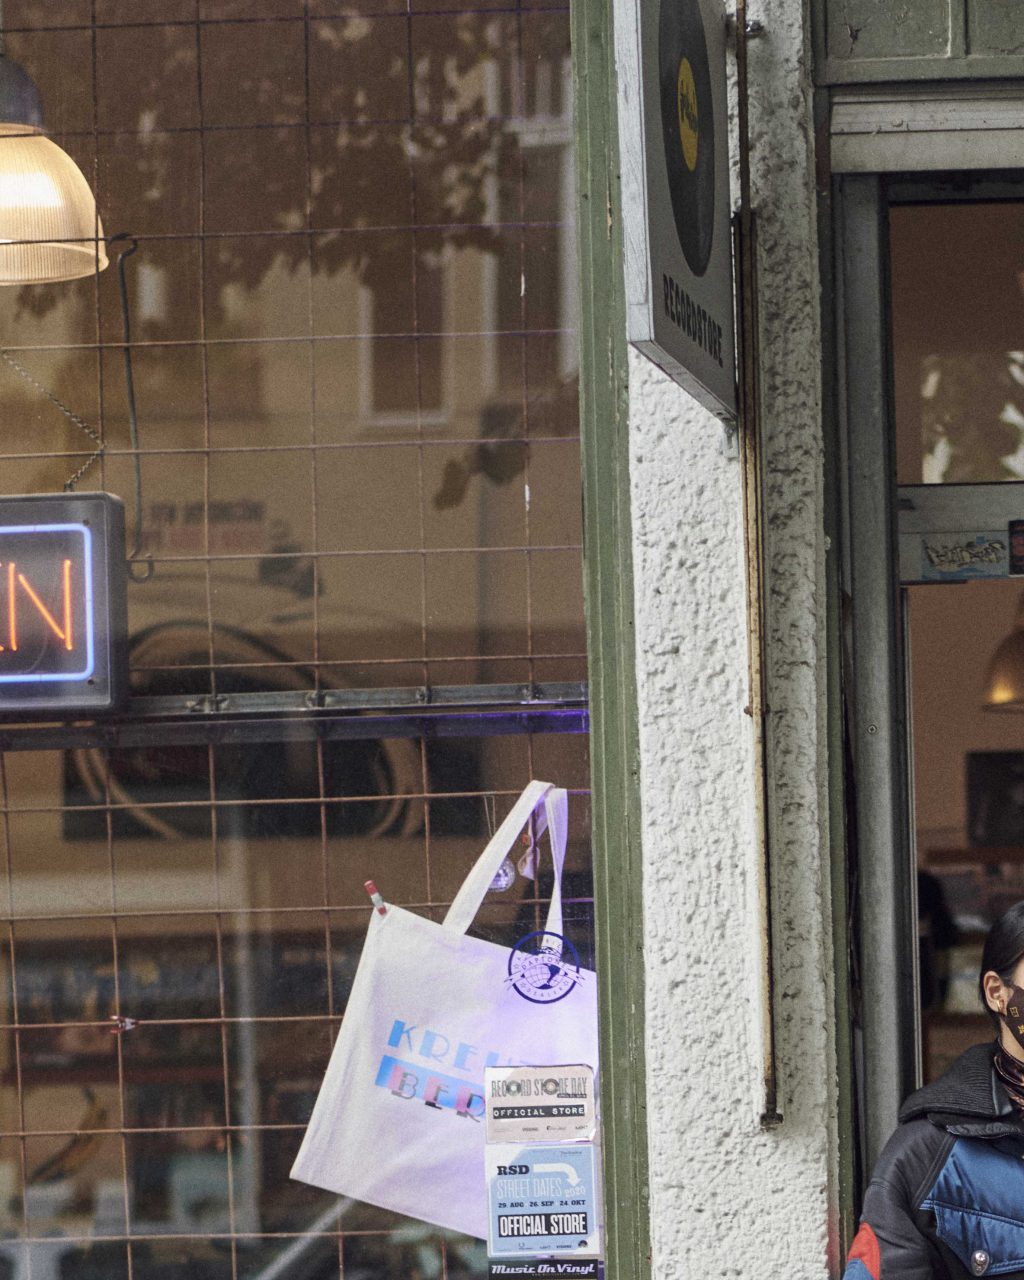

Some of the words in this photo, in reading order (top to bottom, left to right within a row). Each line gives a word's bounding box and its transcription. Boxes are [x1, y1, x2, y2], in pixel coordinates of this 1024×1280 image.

[663, 273, 723, 368] RECORDSTORE
[491, 1079, 532, 1097] RECORD
[534, 1078, 568, 1096] STORE
[570, 1077, 587, 1095] DAY
[493, 1108, 545, 1117] OFFICIAL
[552, 1107, 584, 1115] STORE
[497, 1165, 529, 1175] RSD
[497, 1178, 529, 1199] STREET
[533, 1177, 562, 1198] DATES
[500, 1215, 548, 1236] OFFICIAL
[550, 1214, 586, 1234] STORE
[491, 1265, 536, 1274] Music
[537, 1264, 556, 1274] On
[556, 1263, 595, 1275] Vinyl
